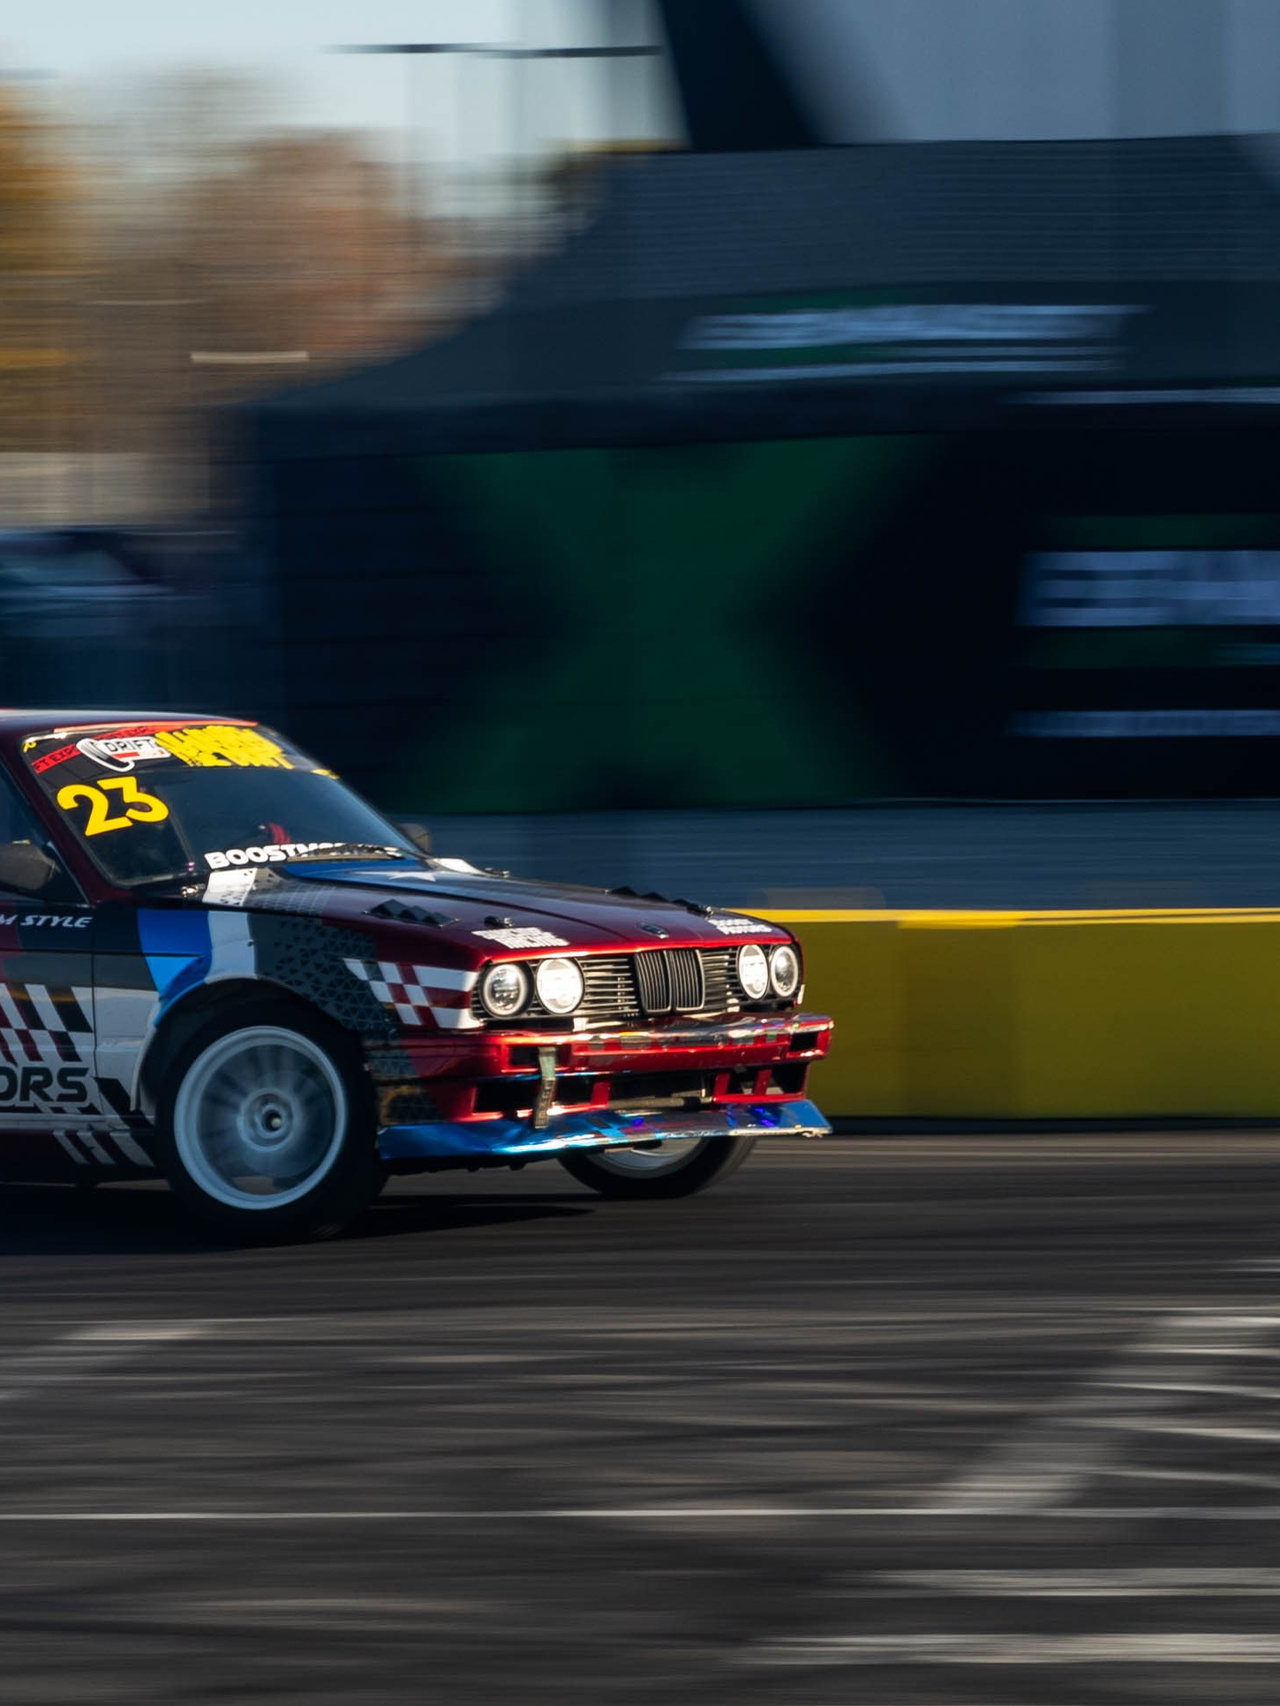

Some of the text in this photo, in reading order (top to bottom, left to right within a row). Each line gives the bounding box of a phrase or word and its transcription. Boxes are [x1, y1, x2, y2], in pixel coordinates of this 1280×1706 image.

[104, 739, 156, 753] DRIFT
[56, 776, 170, 837] 23
[20, 914, 94, 928] STYLE
